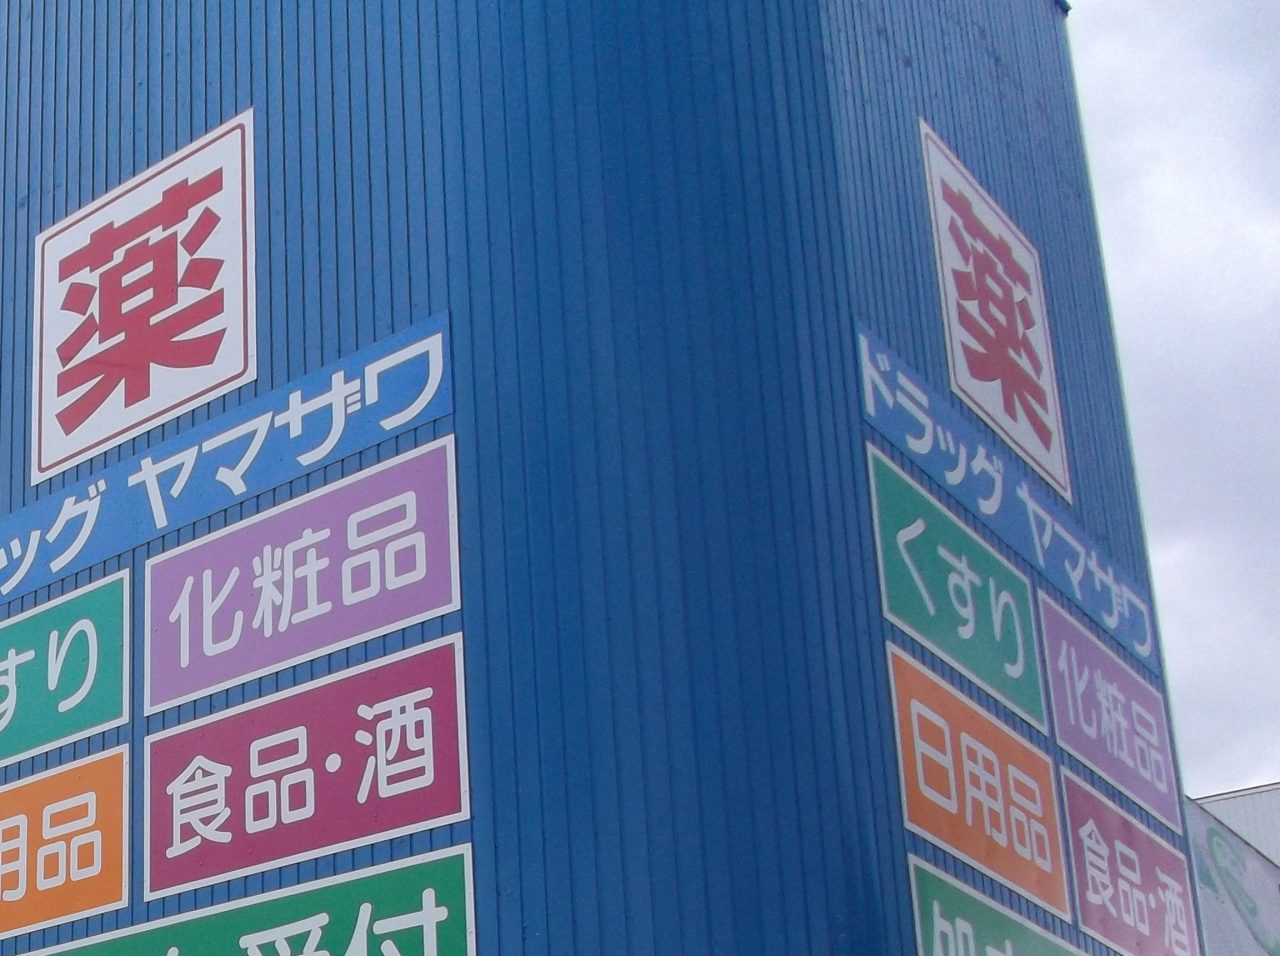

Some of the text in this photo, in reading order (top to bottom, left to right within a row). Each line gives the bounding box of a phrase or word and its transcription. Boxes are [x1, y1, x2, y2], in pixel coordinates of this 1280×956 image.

[55, 166, 228, 438] 薬
[939, 177, 1054, 454] 薬
[127, 331, 444, 531] ヤマザワ
[858, 332, 1153, 657] ドラッグ ヤマザワ
[168, 490, 428, 670] 化粧品
[895, 516, 1027, 679] くすり
[165, 686, 435, 860] 食品・酒
[910, 698, 1053, 874] 日用品
[1055, 639, 1168, 796] 化粧品
